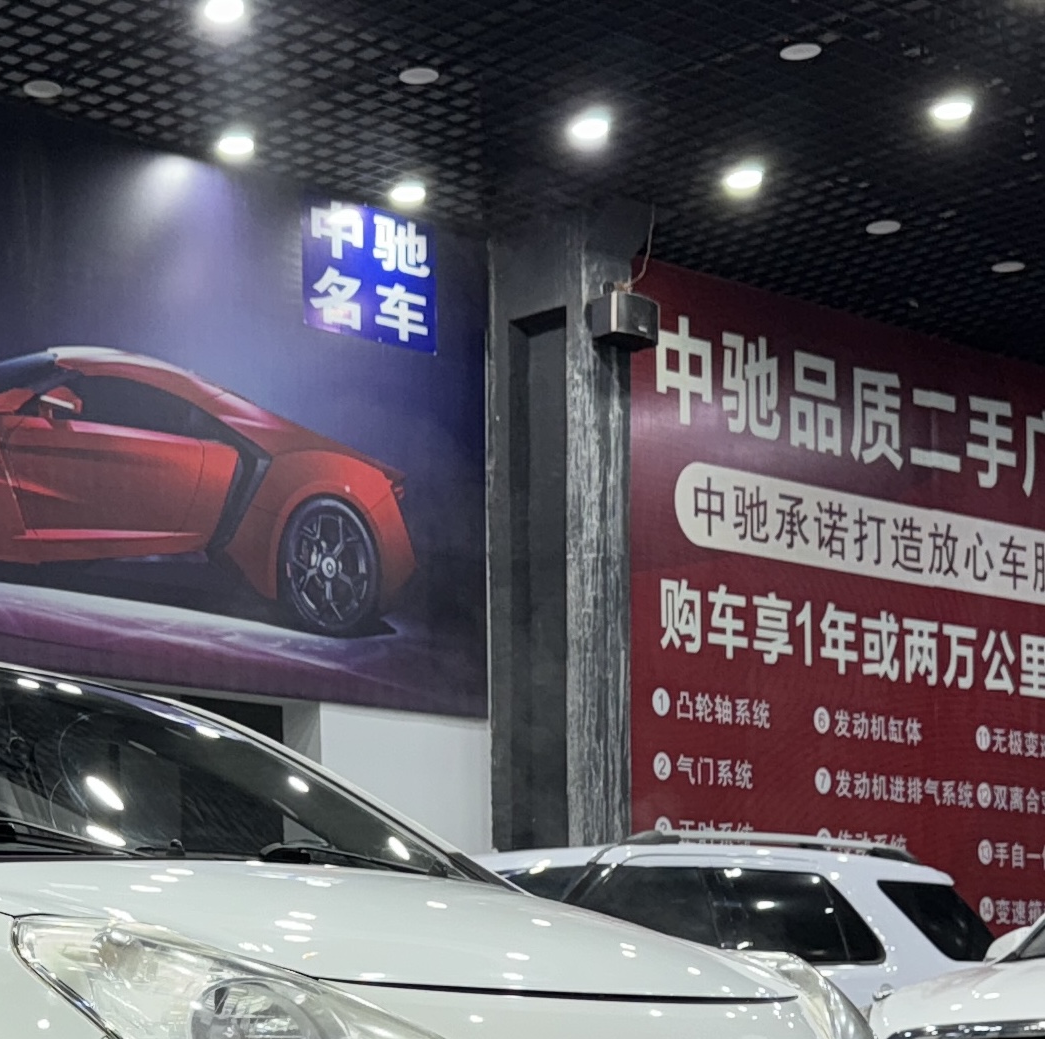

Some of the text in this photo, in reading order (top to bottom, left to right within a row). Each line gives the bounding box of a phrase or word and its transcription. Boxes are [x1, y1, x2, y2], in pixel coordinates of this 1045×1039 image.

[310, 200, 430, 278] 中驰
[310, 266, 428, 342] 名车
[659, 578, 1045, 698] 购车享1年或两万公里
[676, 690, 771, 729] 凸轮轴系统
[834, 708, 923, 746] 发动机缸体
[676, 753, 754, 790] 气门系统
[835, 769, 974, 808] 发动机进排气系统
[993, 841, 1045, 870] 手自一
[995, 898, 1045, 925] 变速箱
